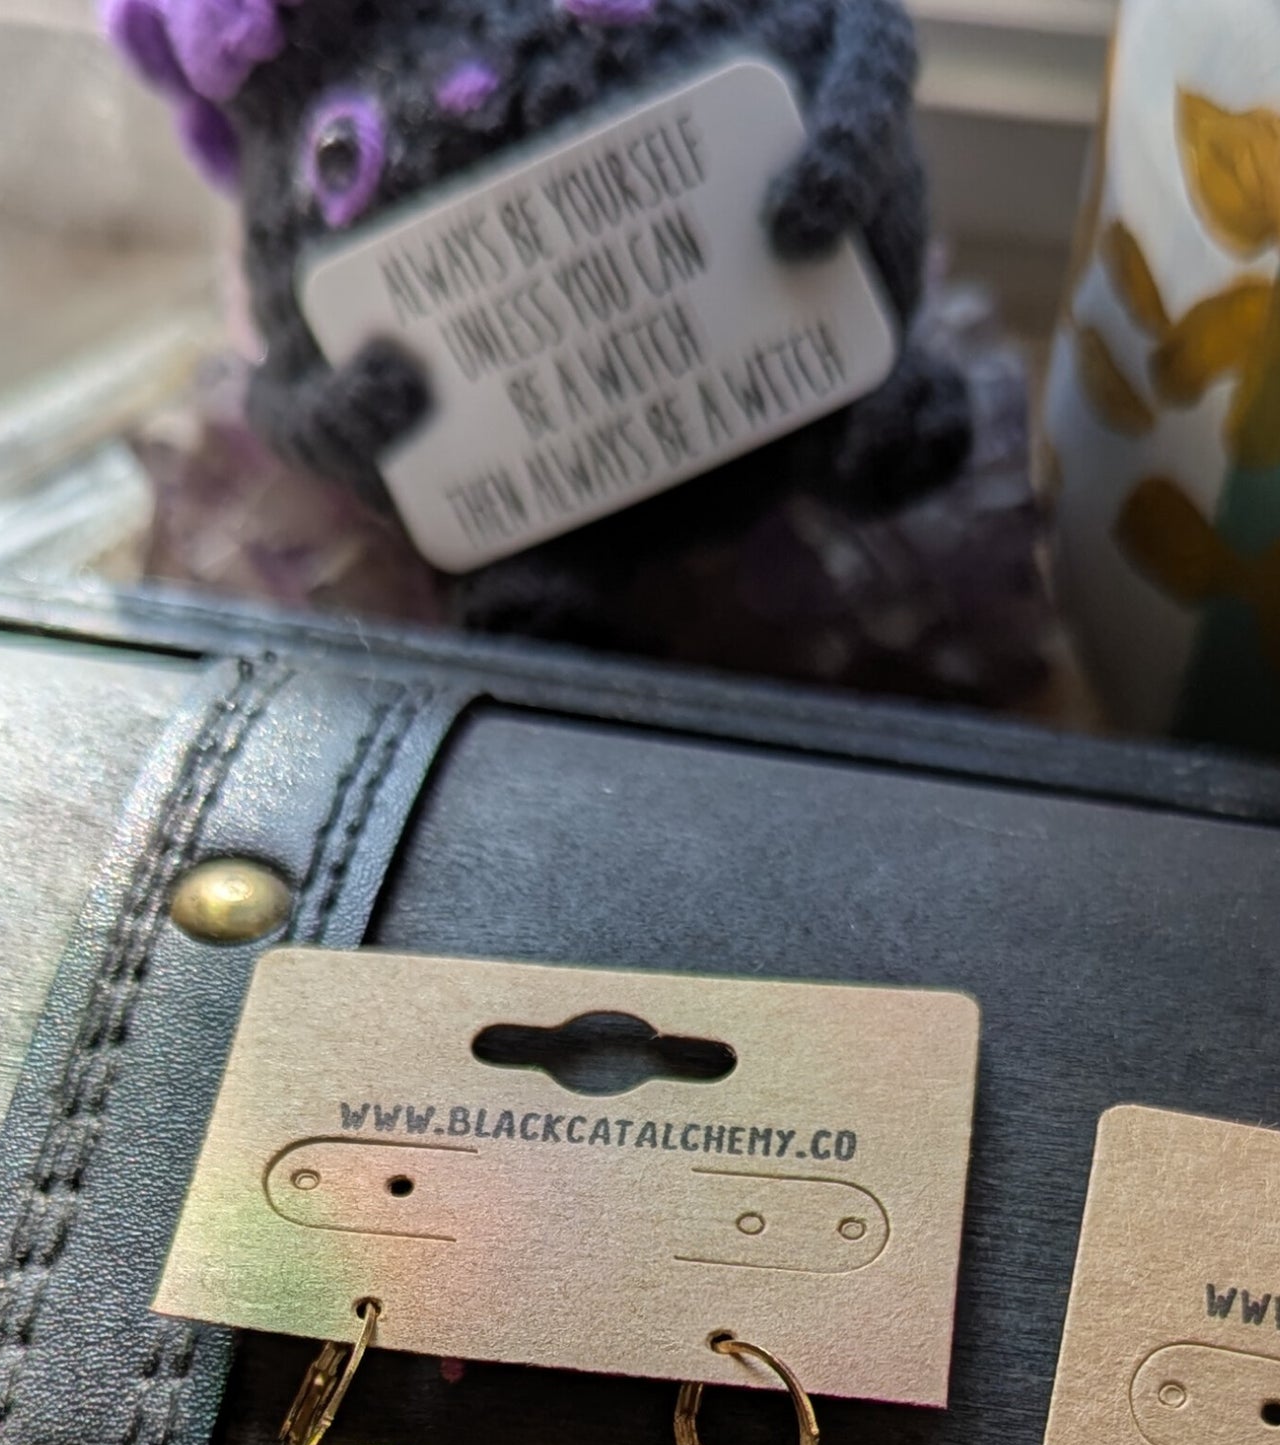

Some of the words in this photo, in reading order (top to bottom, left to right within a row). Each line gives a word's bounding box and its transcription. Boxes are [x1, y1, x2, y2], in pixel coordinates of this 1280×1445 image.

[540, 114, 707, 244] YOURSELF
[439, 274, 566, 383] UNLESS
[552, 244, 632, 331] YOU
[624, 208, 707, 299] CAN
[445, 466, 532, 550] THEN
[525, 414, 654, 525] ALWAYS
[643, 391, 701, 469] BE
[696, 378, 734, 445] A
[723, 321, 849, 428] WITCH
[506, 366, 560, 441] BE
[553, 354, 593, 424] A
[577, 300, 705, 406] WITCH
[339, 1101, 858, 1163] WWW.BLACKCATALCHEMY.CO
